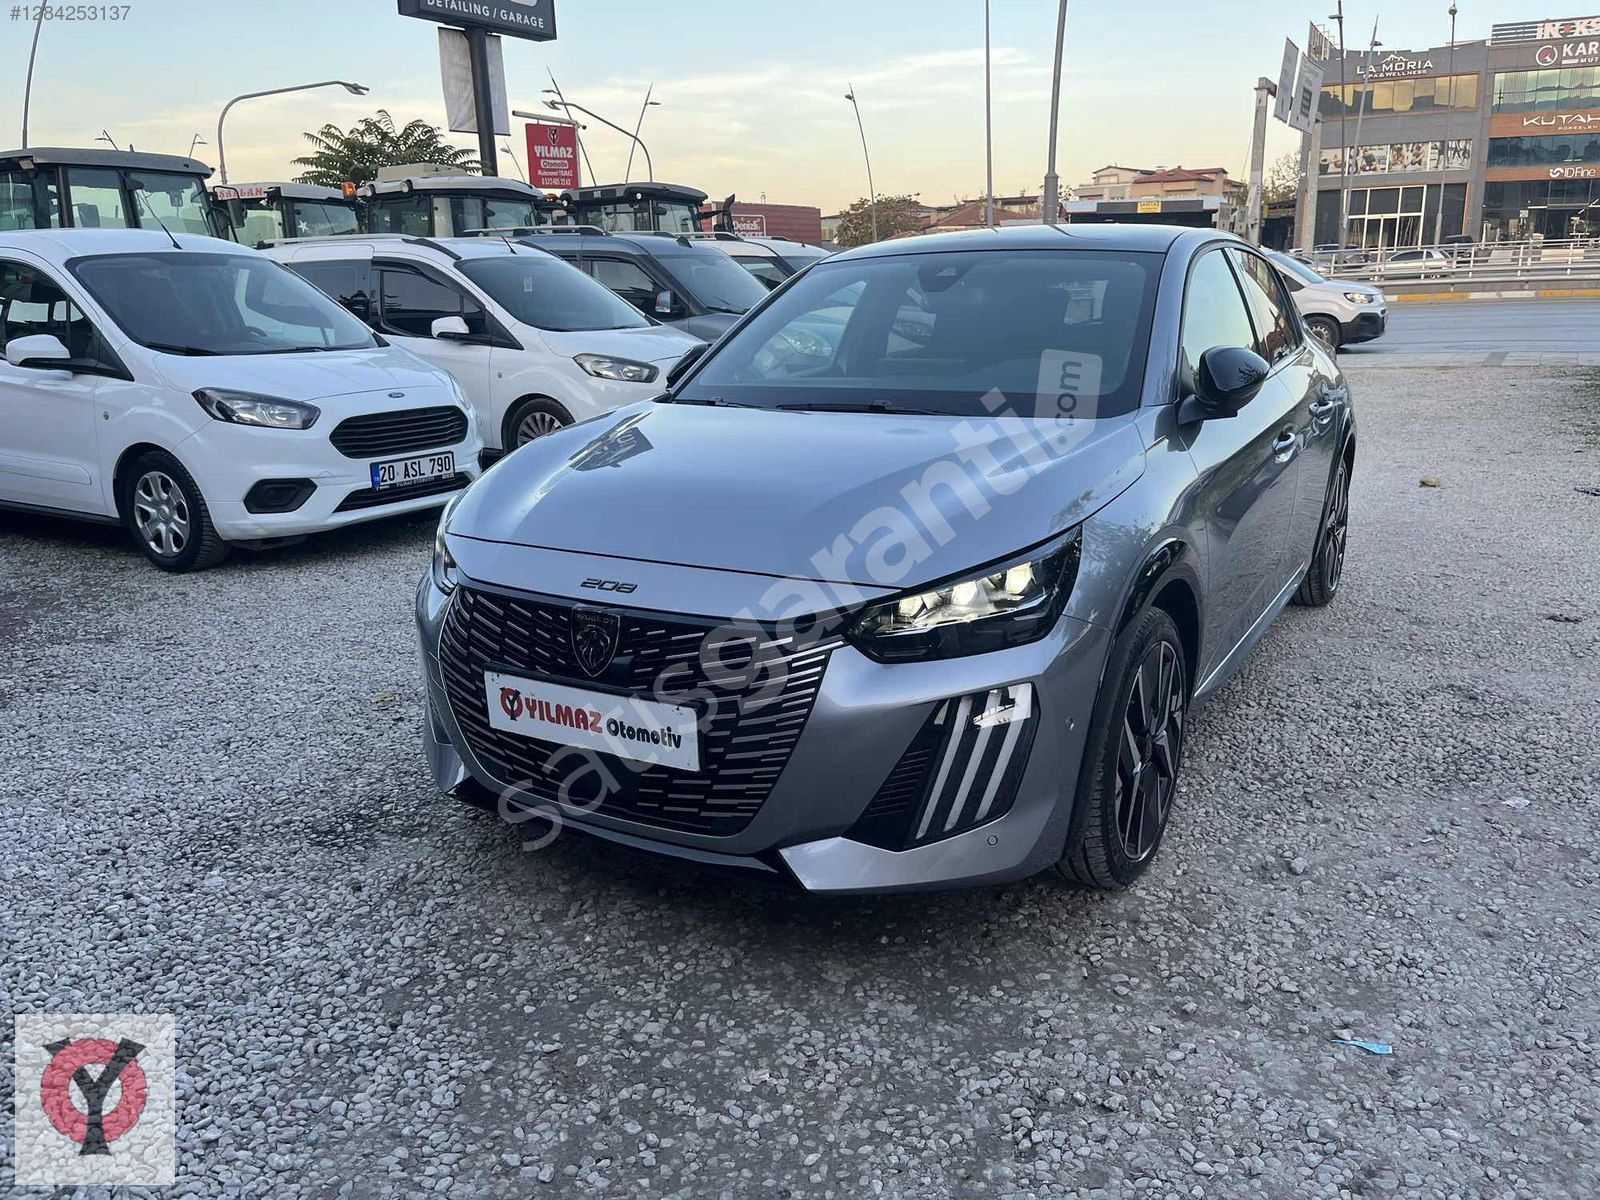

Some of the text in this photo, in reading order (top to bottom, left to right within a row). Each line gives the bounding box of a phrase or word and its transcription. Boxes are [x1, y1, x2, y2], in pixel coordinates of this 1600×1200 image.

[493, 7, 497, 18] /
[500, 9, 544, 29] GARAGE
[1382, 60, 1434, 72] MORIA
[534, 145, 573, 158] YILMAZ
[380, 456, 451, 482] 20 ASL 790
[580, 578, 638, 593] 208
[524, 695, 603, 734] YILMAZ
[606, 716, 682, 749] Otomotiv
